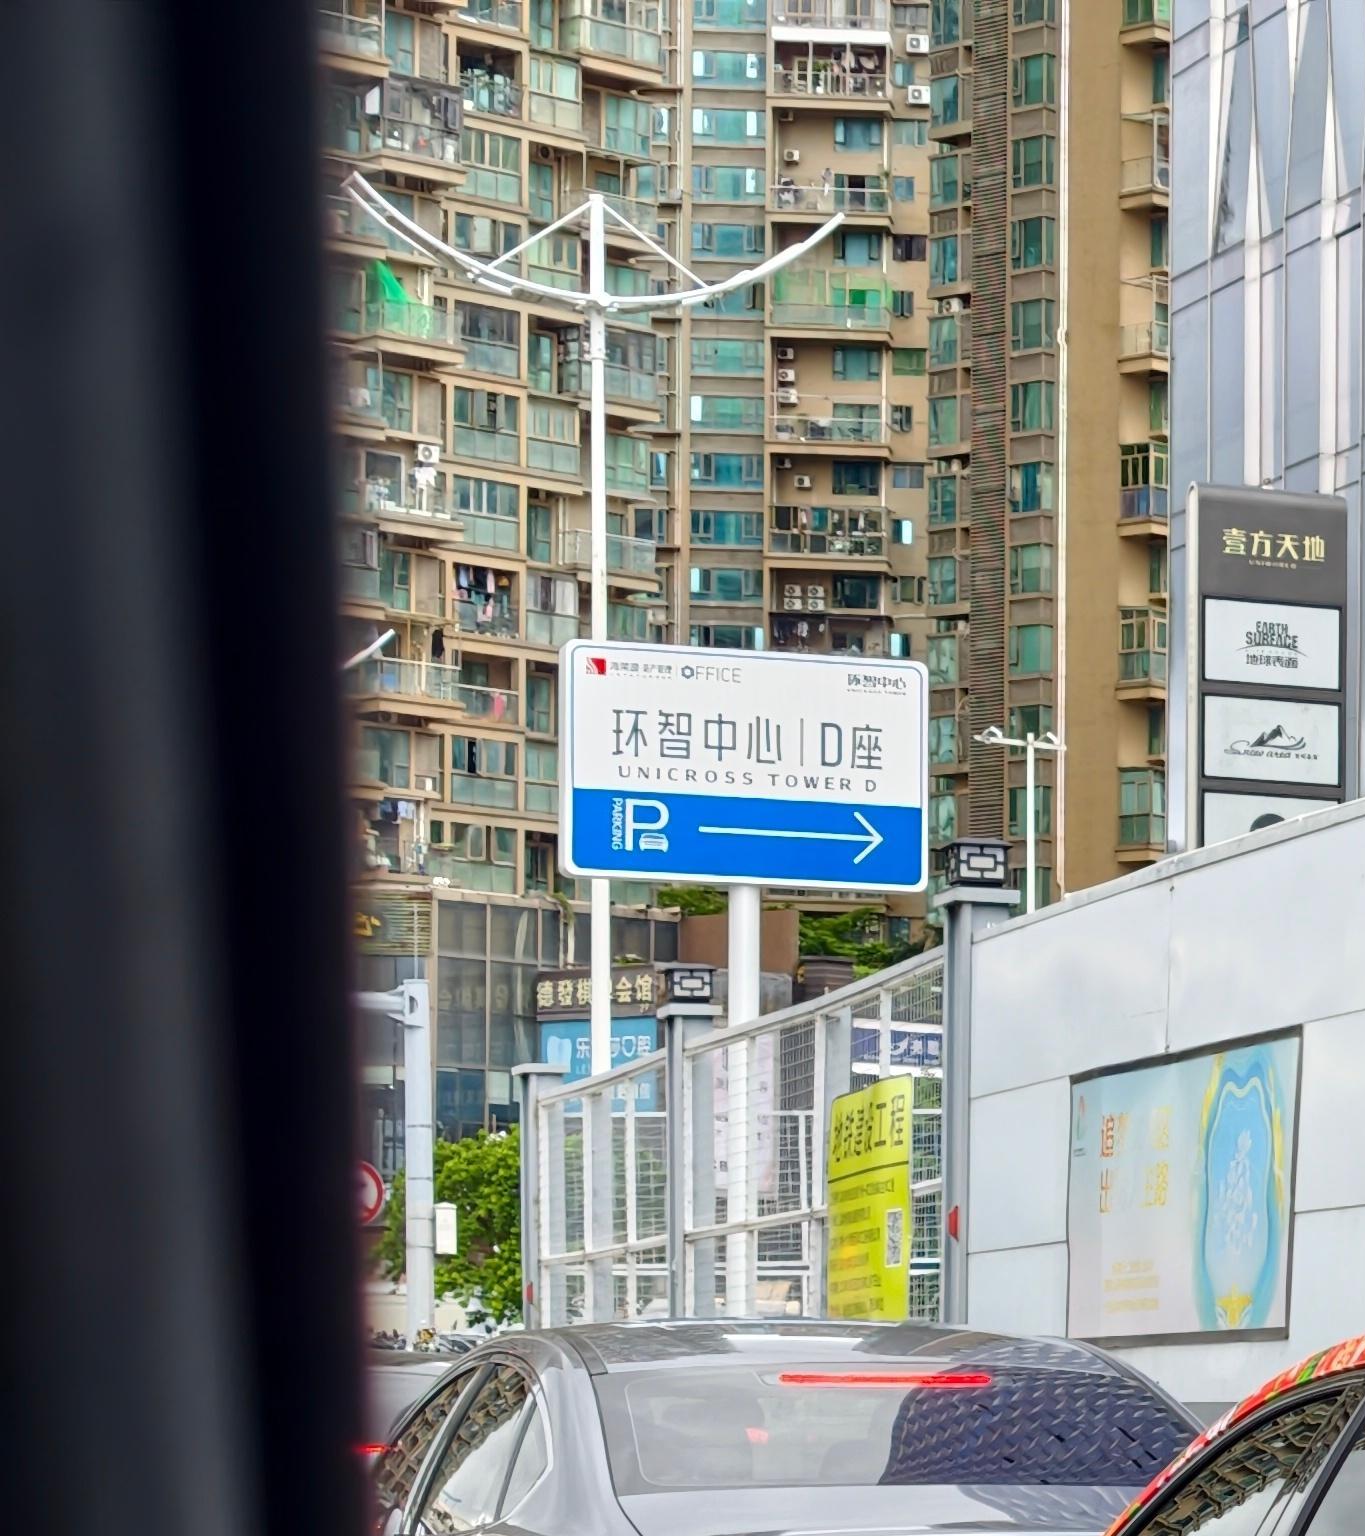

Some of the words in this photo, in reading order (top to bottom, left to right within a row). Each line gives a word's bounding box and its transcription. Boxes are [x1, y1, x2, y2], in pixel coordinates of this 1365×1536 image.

[1222, 528, 1325, 562] 壹方天地
[1245, 631, 1299, 648] SURFACE
[1255, 621, 1288, 634] EARTH
[681, 665, 741, 683] OFFICE
[612, 709, 782, 765] 环智中心
[821, 722, 883, 770] D座
[618, 765, 753, 786] UNICROSS
[768, 774, 851, 792] TOWER
[865, 779, 877, 792] D
[612, 797, 623, 850] PARKING
[536, 974, 653, 1008] 德發棋会馆
